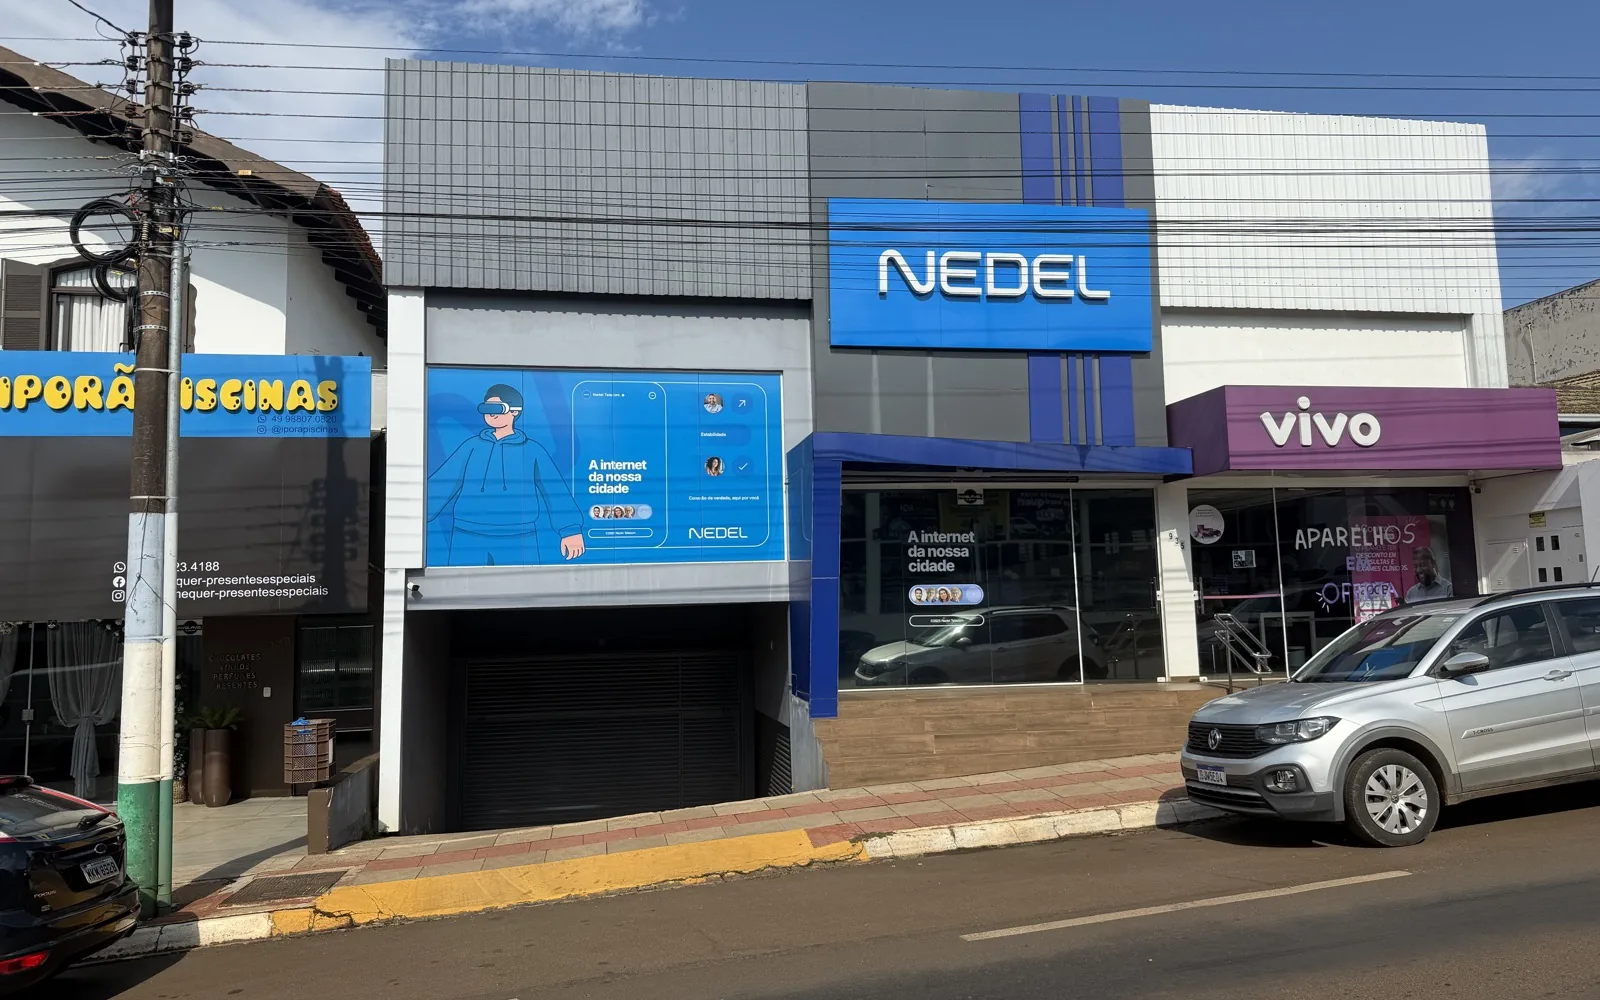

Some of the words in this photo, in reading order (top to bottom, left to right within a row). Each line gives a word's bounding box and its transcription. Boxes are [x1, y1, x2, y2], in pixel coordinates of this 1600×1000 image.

[878, 249, 1110, 298] NEDEL
[0, 363, 135, 412] IPORÃ
[180, 377, 338, 413] ISCINAS
[271, 415, 283, 423] 49
[1260, 396, 1381, 448] vivo
[588, 459, 599, 470] A
[600, 459, 648, 470] internet
[588, 471, 604, 482] da
[605, 473, 642, 482] nossa
[588, 482, 630, 494] cidade
[688, 527, 748, 539] NEDEL
[907, 530, 920, 543] A
[921, 529, 975, 543] internet
[1295, 523, 1416, 551] APARELHOS
[907, 545, 926, 557] da
[927, 547, 969, 558] nossa
[176, 561, 220, 572] 23.4188
[908, 559, 955, 573] cidade
[176, 573, 316, 587] quer-presentesespeciais
[176, 586, 329, 600] equer-presentesespeciais
